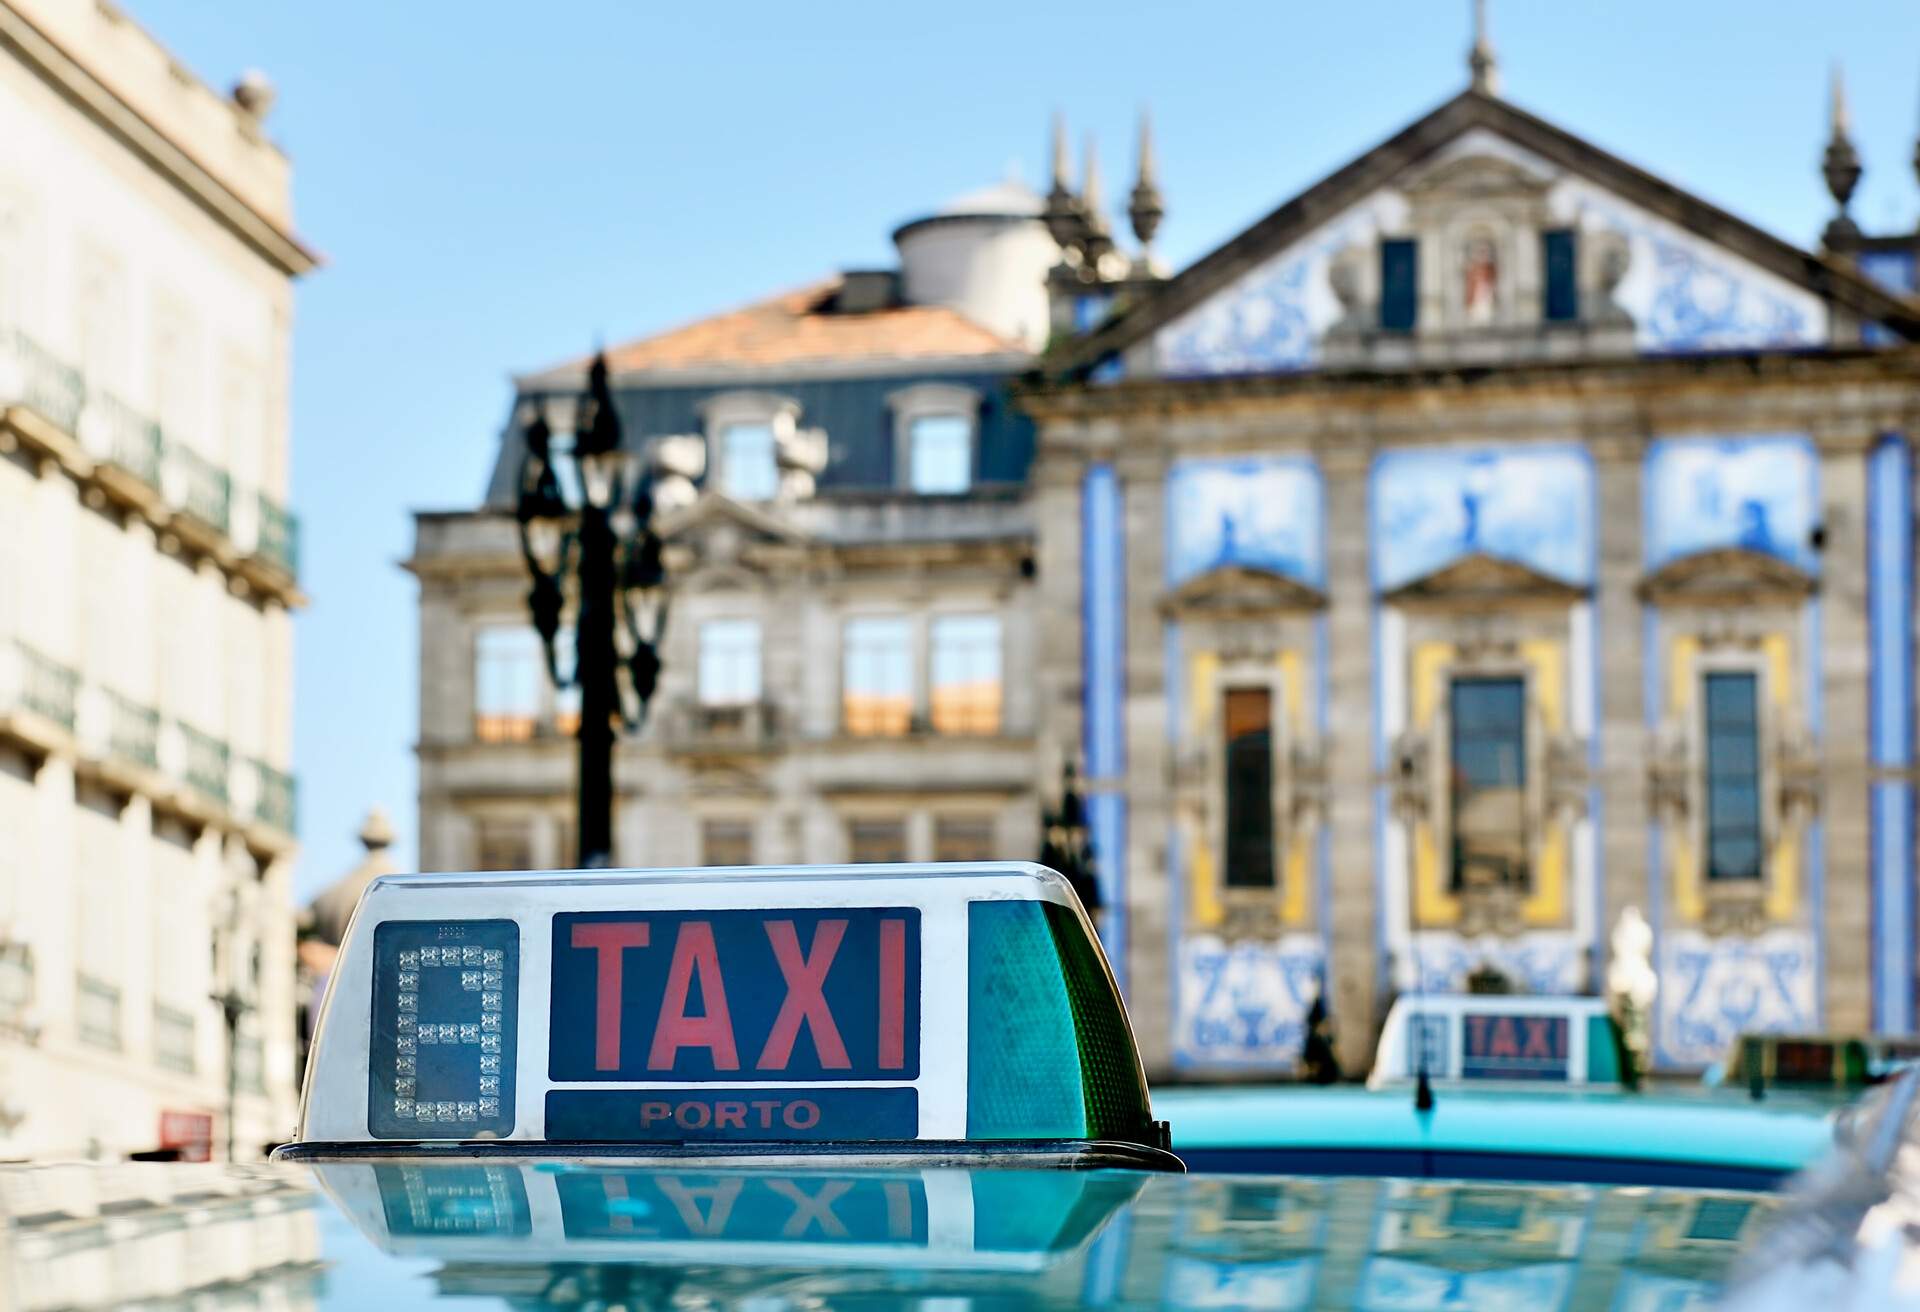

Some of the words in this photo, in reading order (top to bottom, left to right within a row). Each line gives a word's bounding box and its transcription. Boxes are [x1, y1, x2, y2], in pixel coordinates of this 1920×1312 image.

[571, 919, 906, 1071] TAXI
[1469, 1017, 1568, 1058] TAXI
[640, 1100, 821, 1130] PORTO
